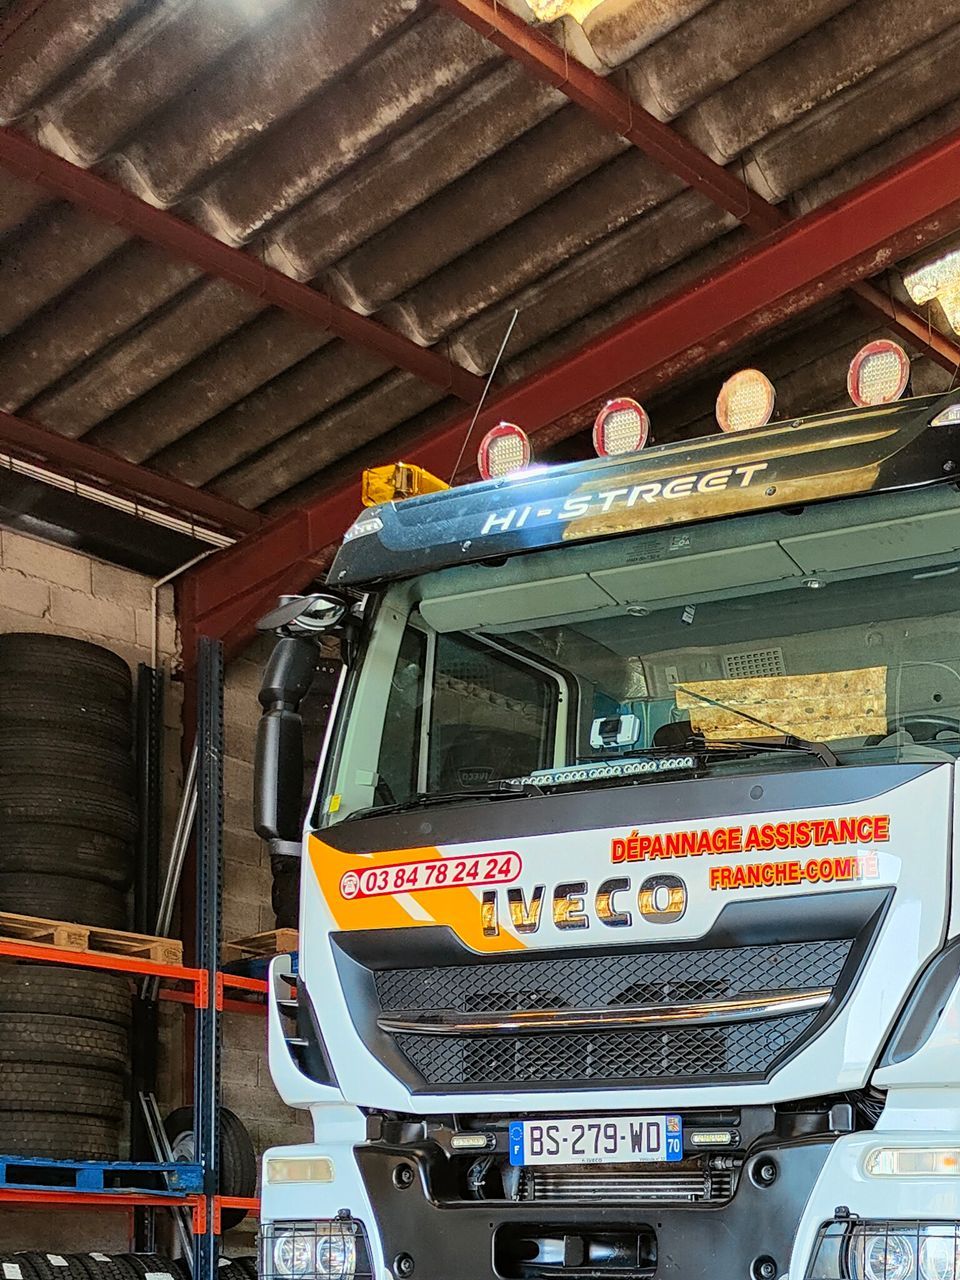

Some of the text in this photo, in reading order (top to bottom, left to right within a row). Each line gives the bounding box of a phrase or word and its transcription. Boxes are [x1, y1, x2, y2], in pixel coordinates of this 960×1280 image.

[480, 462, 769, 535] HI-STREET
[611, 814, 891, 864] DÉPANNAGE ASSISTANCE
[365, 856, 512, 892] 03 84 78 24 24
[709, 849, 880, 890] FRANCHE-COMTÉ
[482, 872, 688, 938] IVECO
[514, 1145, 520, 1155] F
[529, 1121, 661, 1156] BS-279-WD
[667, 1138, 680, 1153] 70
